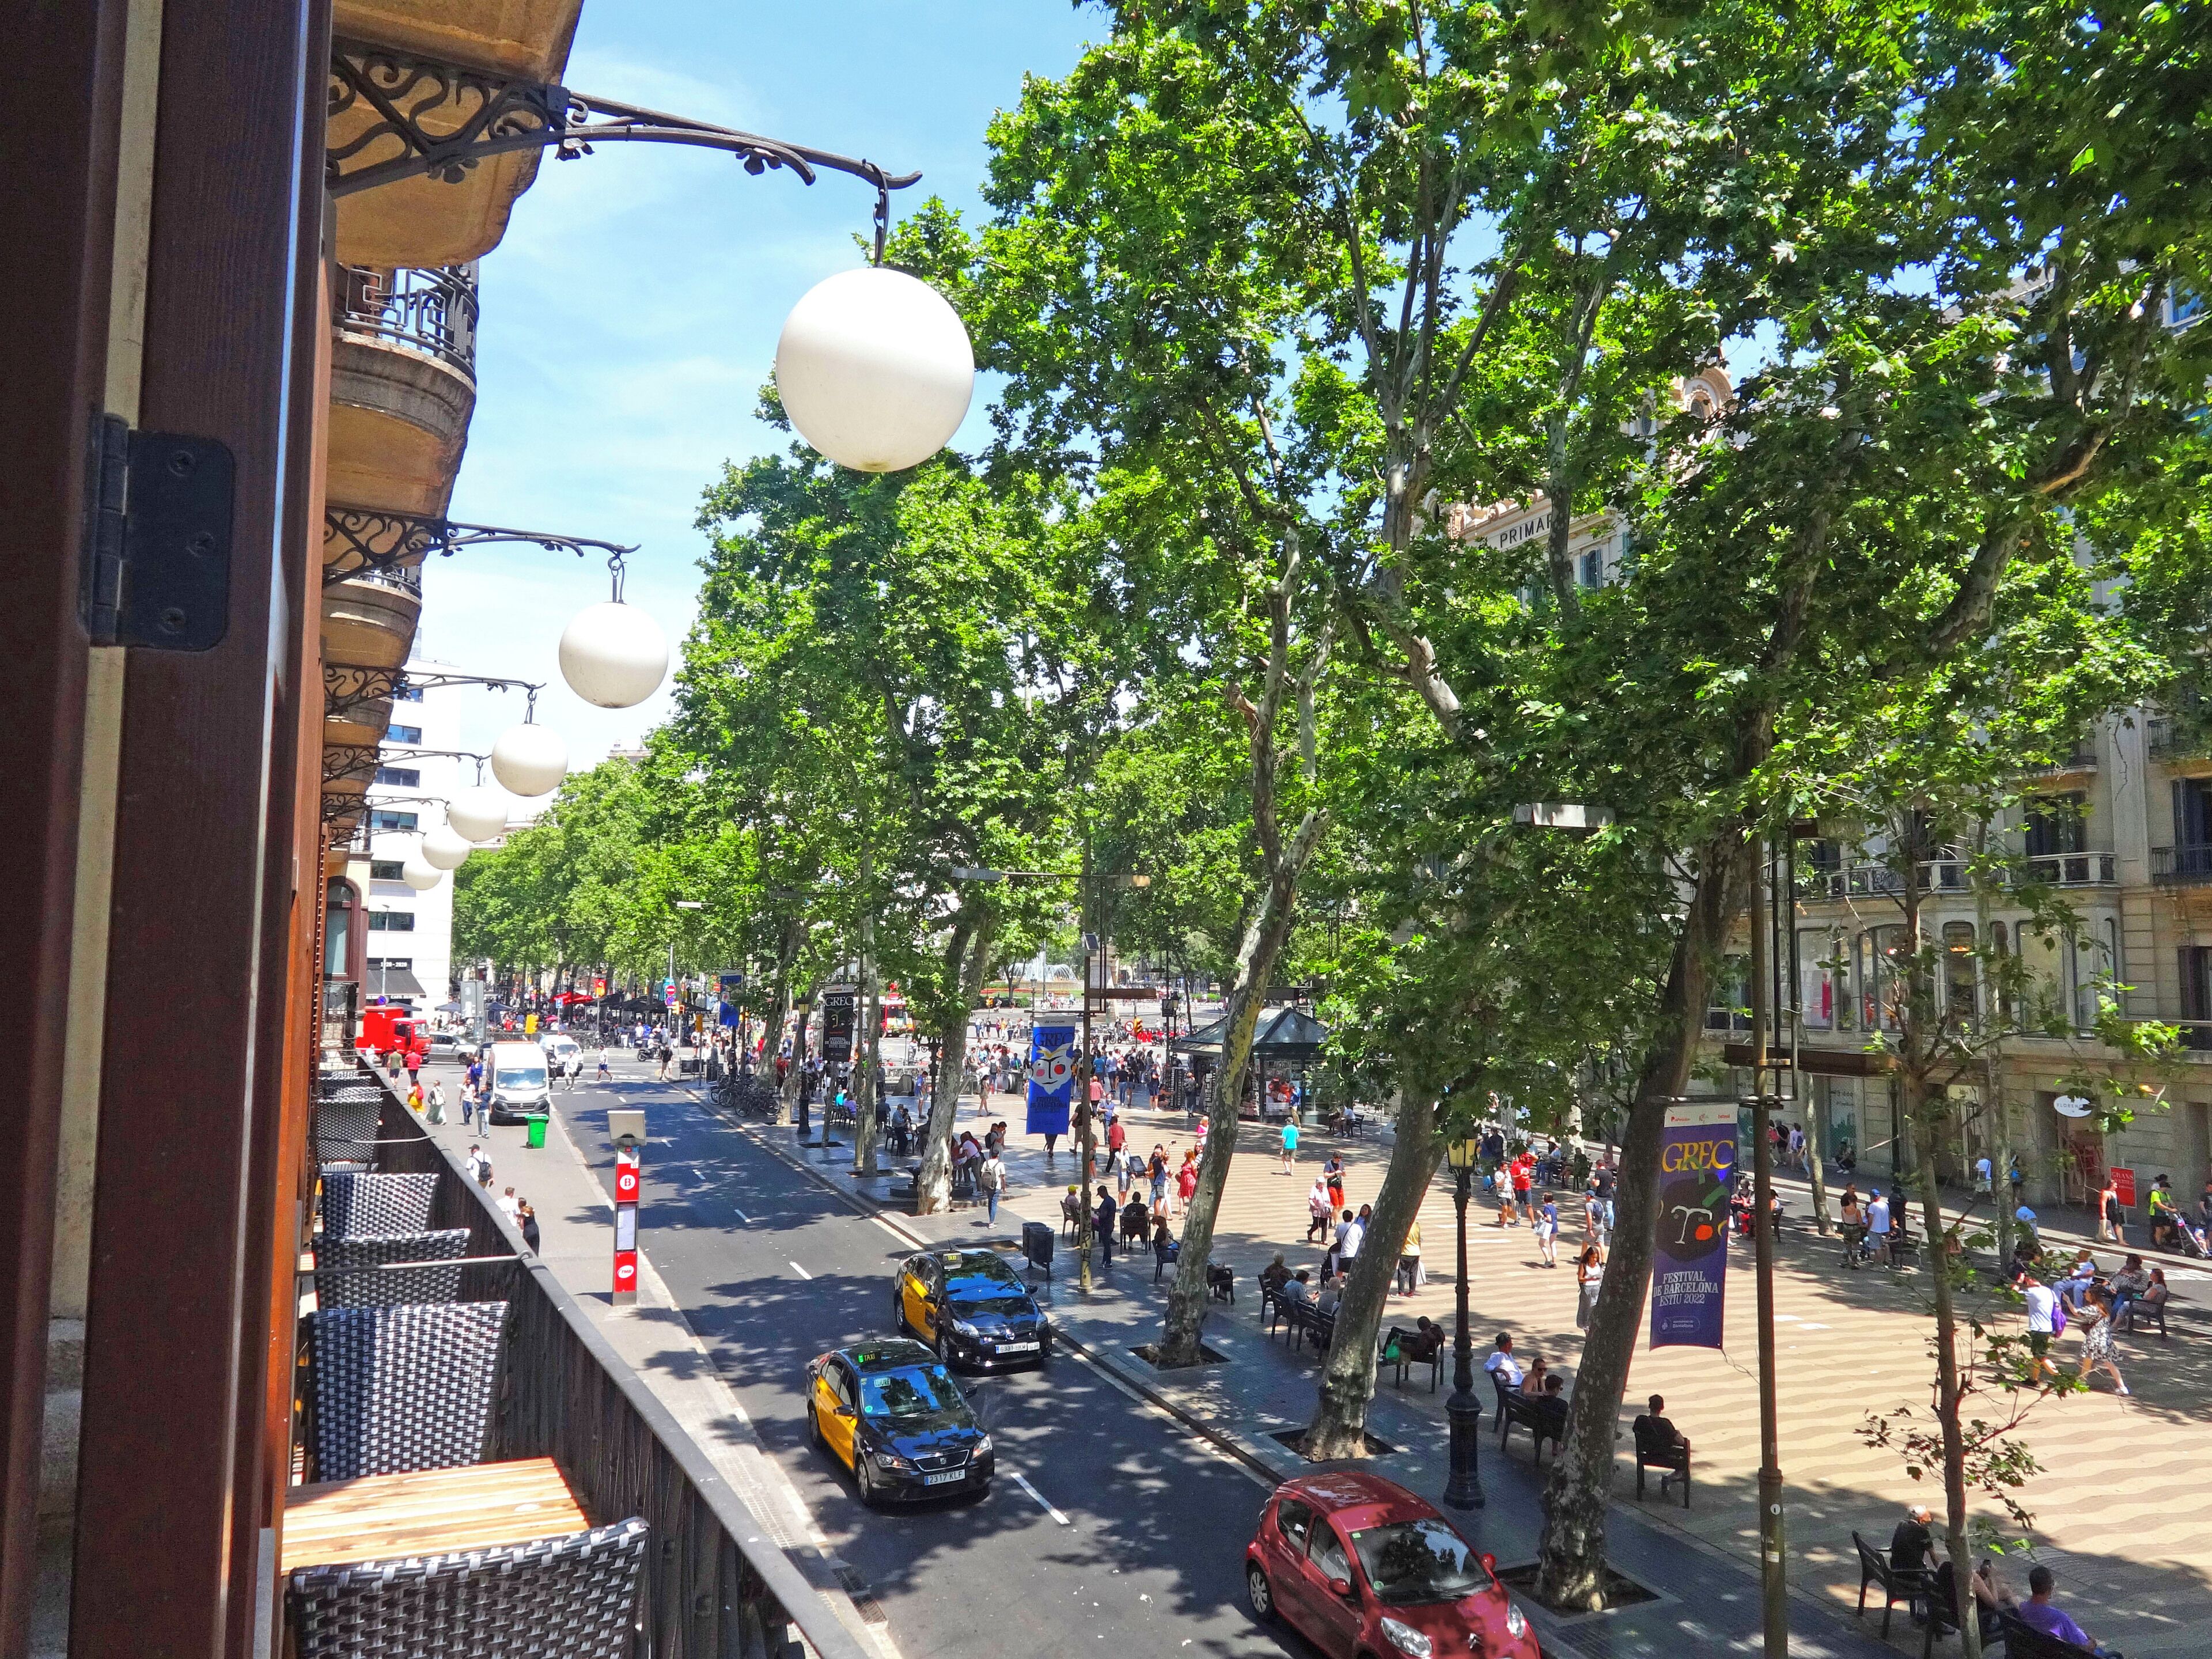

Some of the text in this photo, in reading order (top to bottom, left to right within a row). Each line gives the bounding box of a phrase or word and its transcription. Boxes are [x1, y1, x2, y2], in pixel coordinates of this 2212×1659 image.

[825, 996, 853, 1006] GREC
[1033, 1033, 1075, 1047] GREC
[1662, 1139, 1734, 1172] GREC
[624, 1178, 631, 1187] B
[1662, 1271, 1706, 1284] FESTIVAL
[1653, 1282, 1719, 1298] DE BARCELONA
[1659, 1293, 1705, 1307] ESTIU 2022
[864, 1353, 875, 1361] TAXI
[930, 1471, 963, 1483] 2317 KLF
